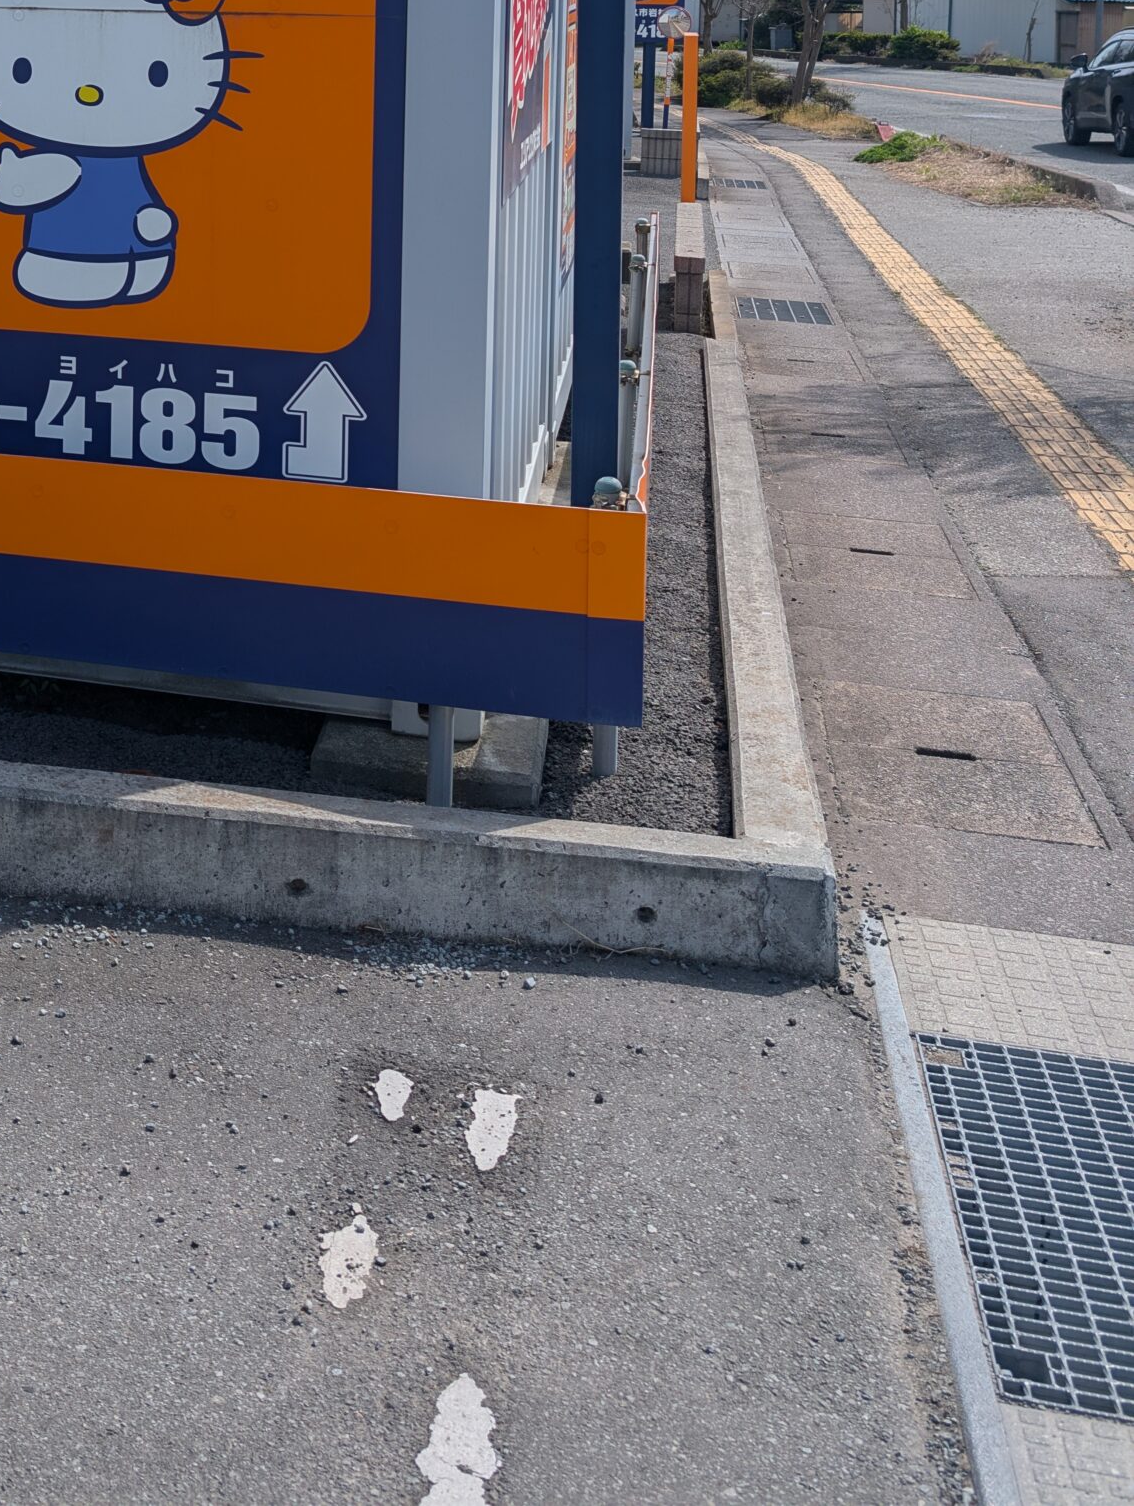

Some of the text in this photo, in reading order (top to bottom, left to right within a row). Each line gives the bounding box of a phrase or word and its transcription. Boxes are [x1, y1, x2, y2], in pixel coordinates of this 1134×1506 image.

[60, 356, 76, 374] ヨ
[109, 361, 126, 379] イ
[156, 363, 177, 383] ハ
[216, 369, 234, 388] コ
